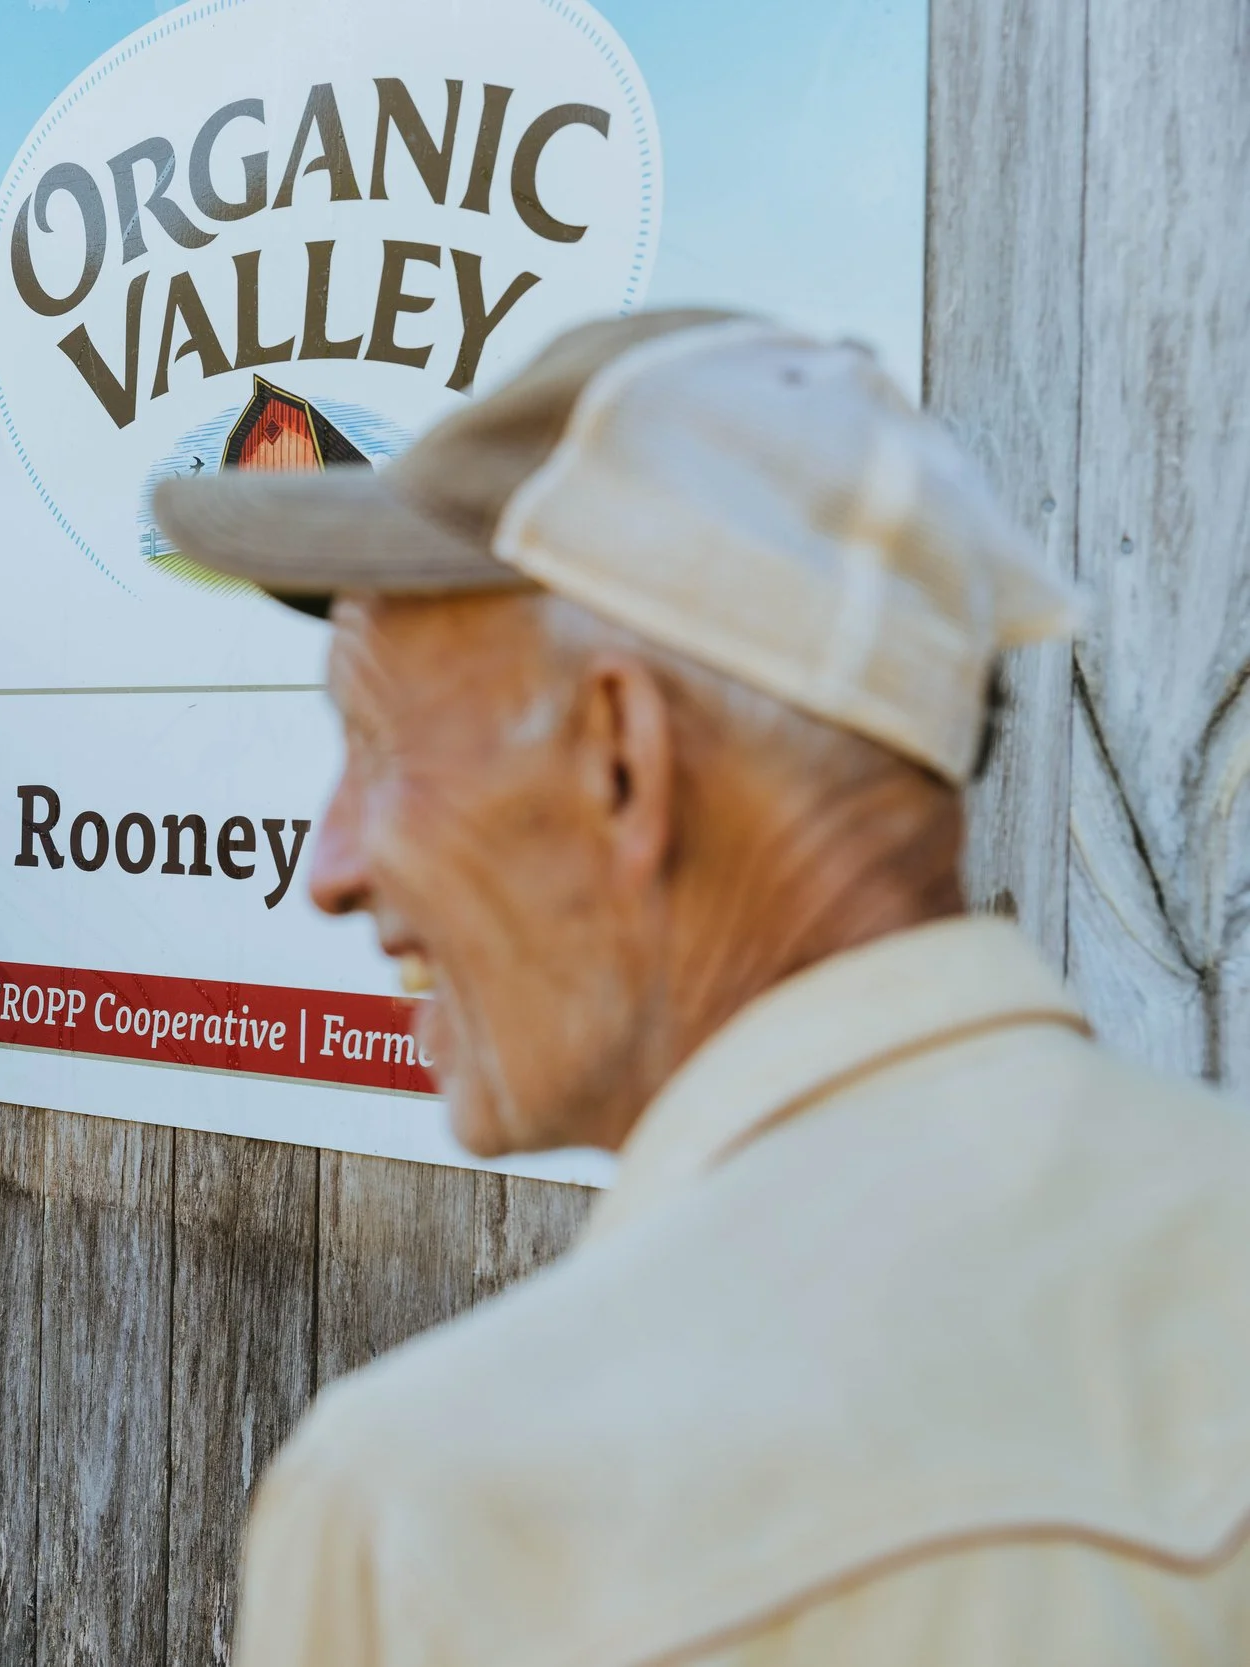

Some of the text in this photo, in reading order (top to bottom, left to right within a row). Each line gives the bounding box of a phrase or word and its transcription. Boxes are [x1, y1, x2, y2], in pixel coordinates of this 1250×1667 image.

[10, 76, 611, 318] ORGANIC
[57, 239, 543, 430] VALLEY
[14, 784, 312, 910] Rooney
[93, 991, 287, 1051] Cooperative
